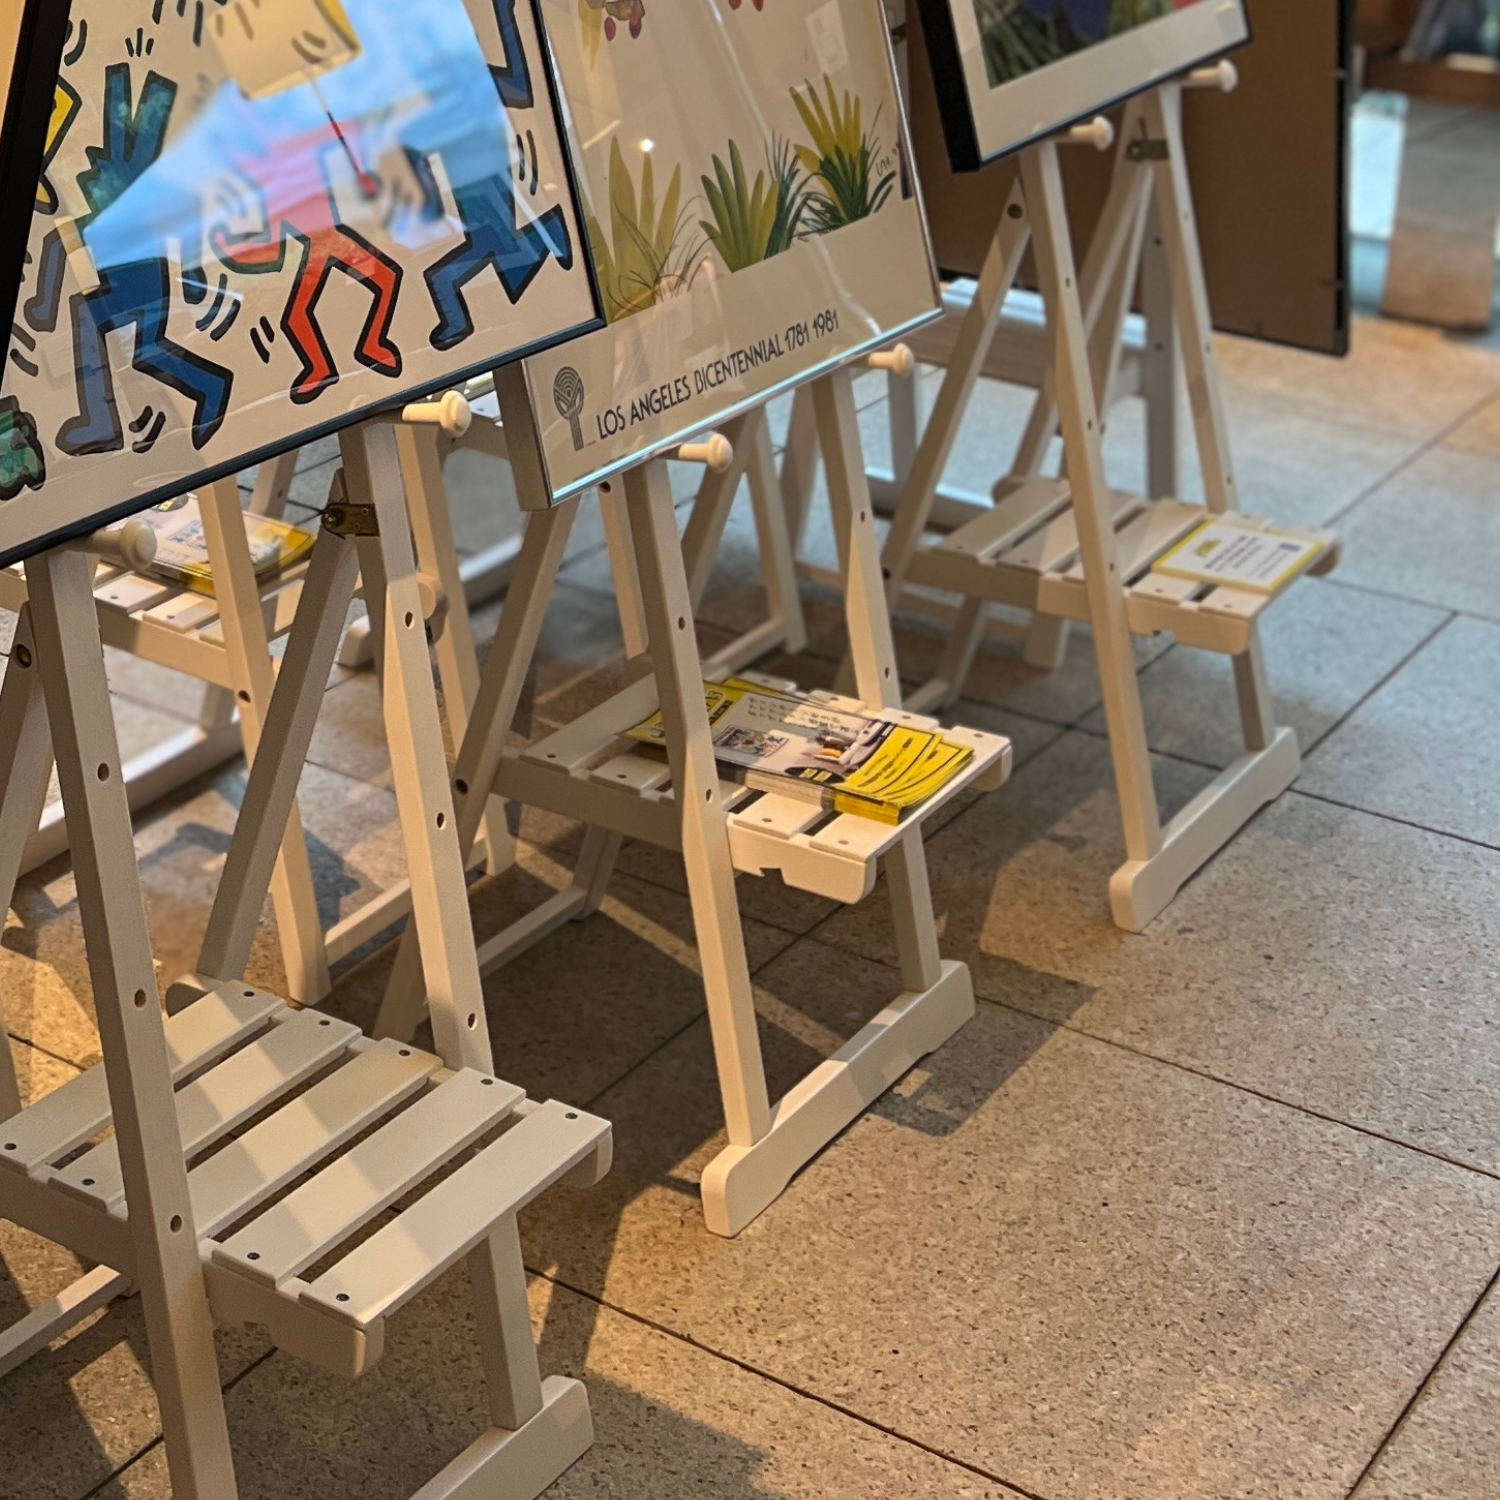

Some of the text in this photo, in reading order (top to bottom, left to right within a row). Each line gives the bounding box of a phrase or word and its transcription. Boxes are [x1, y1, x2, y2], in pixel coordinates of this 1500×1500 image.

[597, 308, 840, 440] LOS ANGELES BICENTENNIAL 1781 1981
